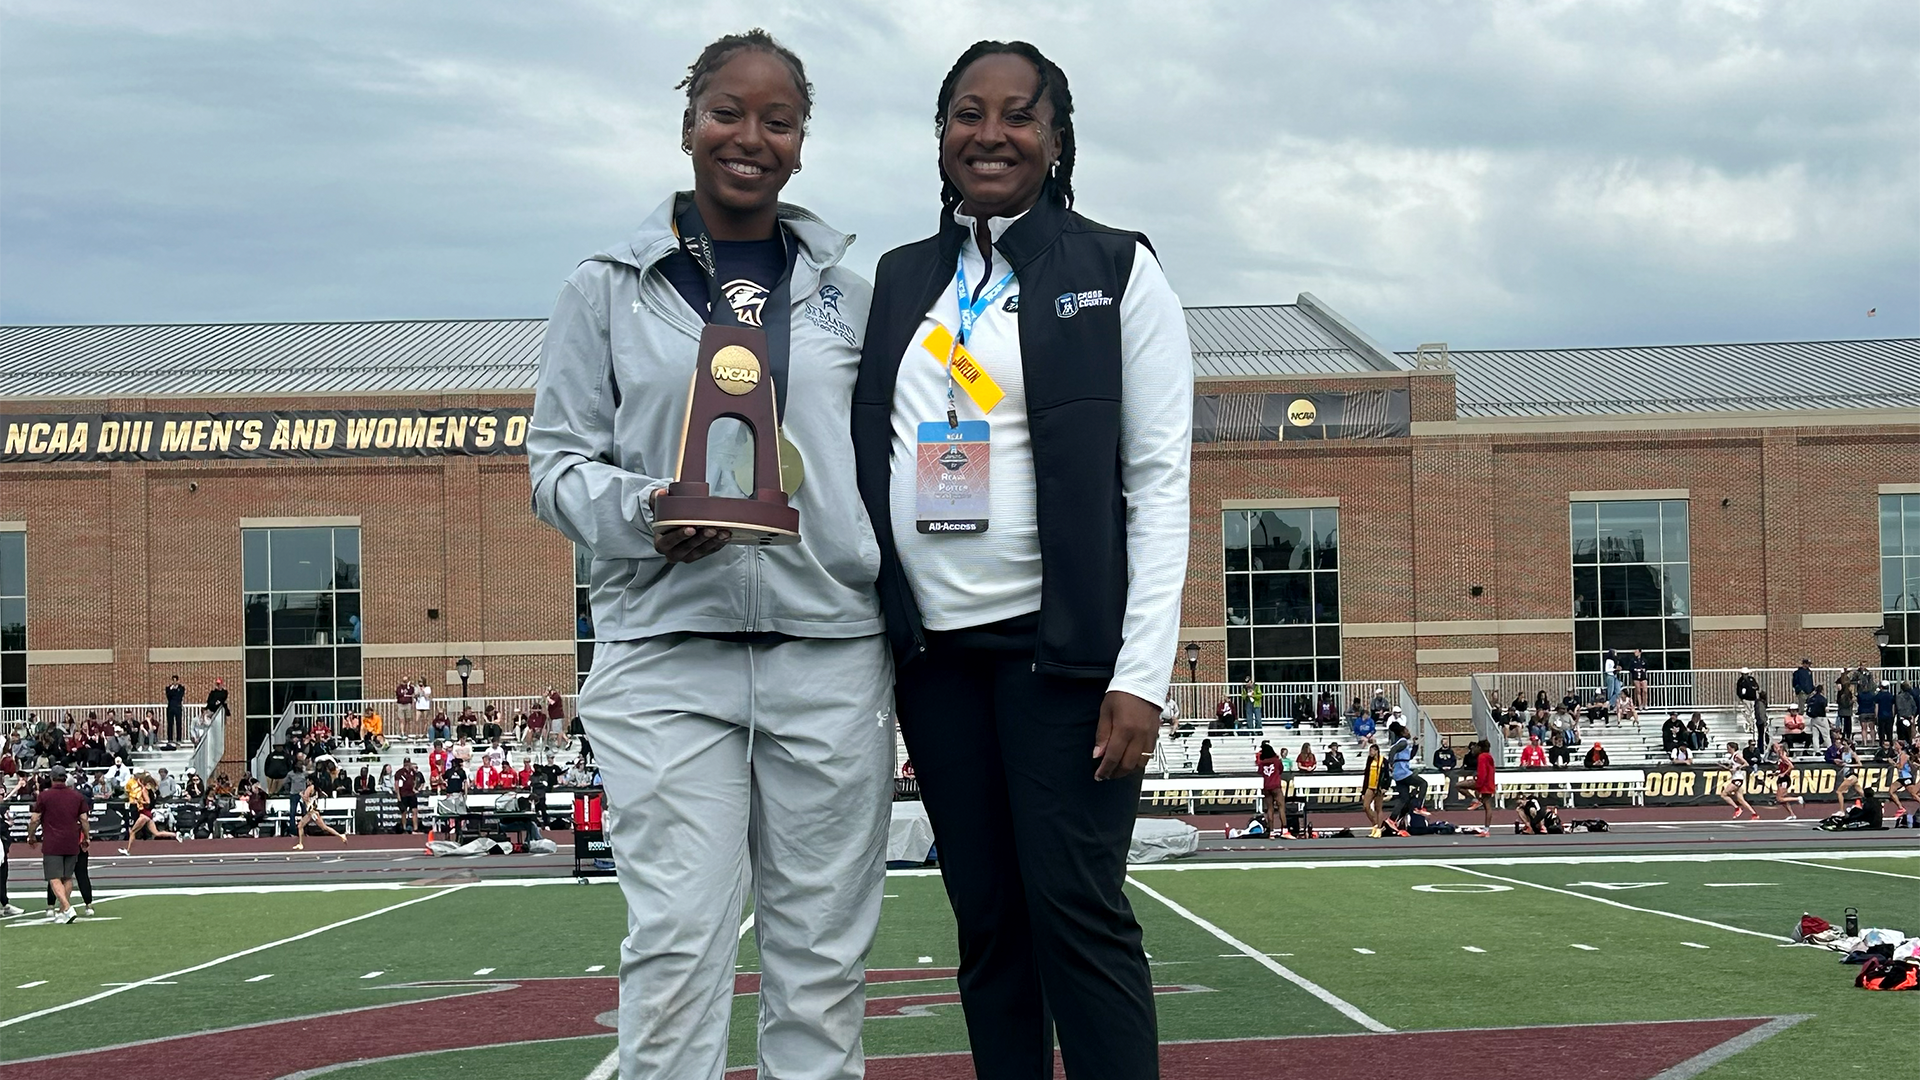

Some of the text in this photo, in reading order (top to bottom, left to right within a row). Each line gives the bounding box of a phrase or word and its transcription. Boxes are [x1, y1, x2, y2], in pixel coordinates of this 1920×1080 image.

[1077, 290, 1103, 300] CROSS
[1079, 297, 1113, 308] COUNTRY
[715, 366, 759, 384] NCAA
[952, 355, 981, 384] JAVELIN
[1292, 412, 1314, 420] NCAA
[4, 422, 88, 455] NCAA
[98, 421, 153, 453] DIII
[160, 419, 263, 452] MEN'S
[269, 418, 337, 451] AND
[346, 416, 496, 450] WOMEN'S
[928, 522, 977, 531] All-Access
[1787, 768, 1837, 794] AND
